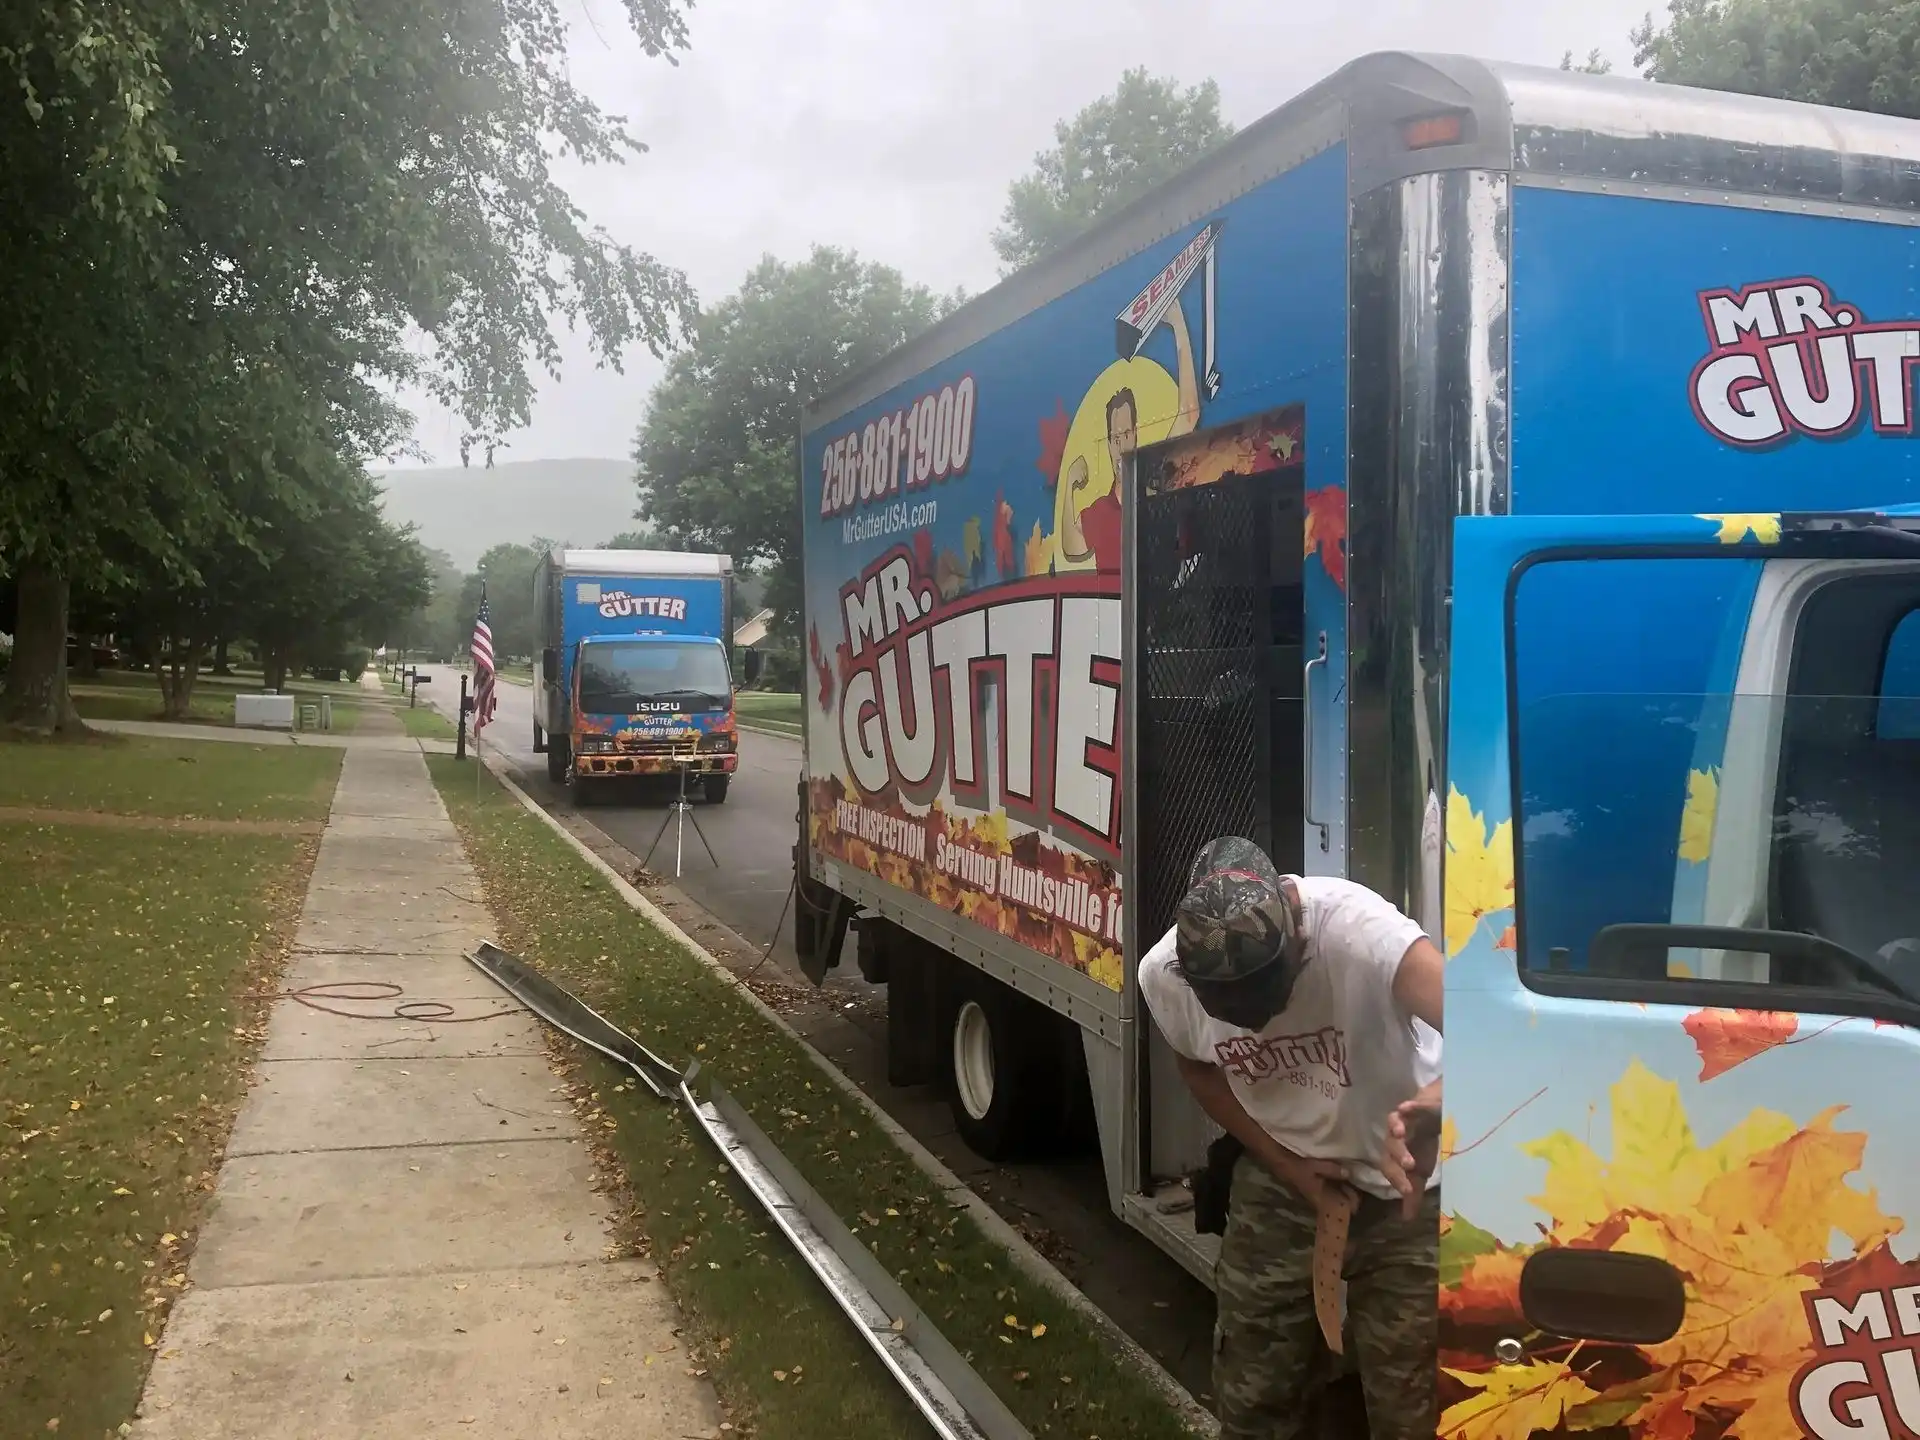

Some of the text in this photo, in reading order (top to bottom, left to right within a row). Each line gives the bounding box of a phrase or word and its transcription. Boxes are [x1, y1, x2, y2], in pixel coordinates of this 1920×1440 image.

[1707, 284, 1854, 346] MR.
[842, 500, 937, 545] MrGutterUSA.com
[600, 597, 686, 620] GUTTER
[601, 591, 631, 602] MR.
[844, 557, 933, 657] MR.
[636, 702, 681, 712] ISUZU
[644, 717, 673, 726] GUTTER
[843, 597, 1122, 836] GUTTE
[836, 799, 858, 834] FREE
[858, 803, 926, 862] INSPECTION
[936, 832, 997, 893] Serving
[1000, 855, 1102, 933] Huntsville
